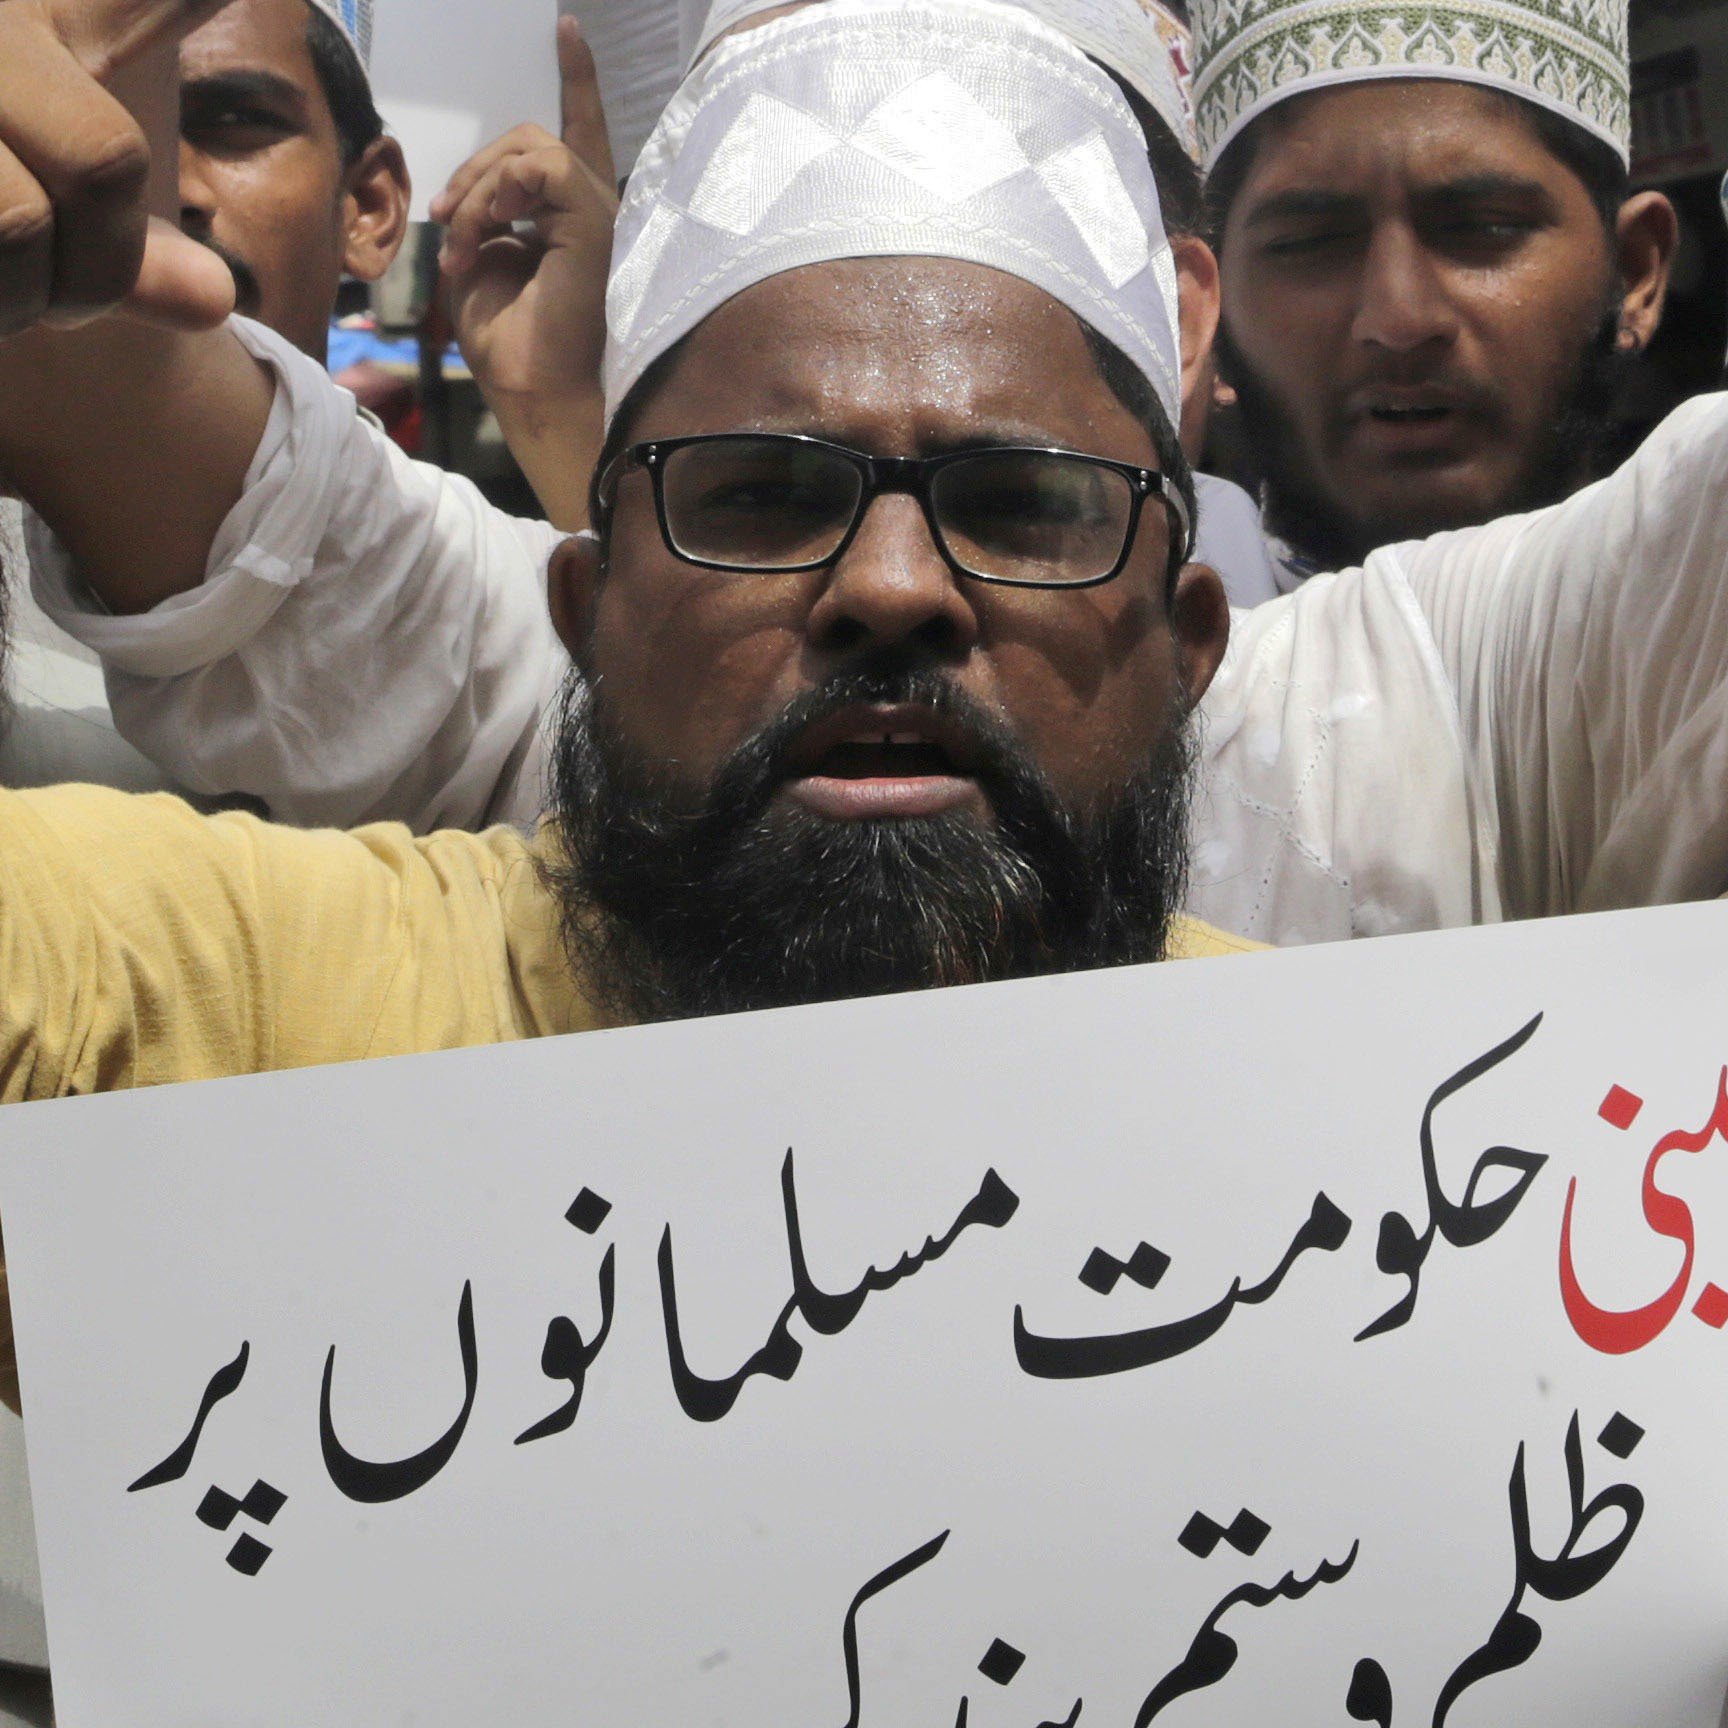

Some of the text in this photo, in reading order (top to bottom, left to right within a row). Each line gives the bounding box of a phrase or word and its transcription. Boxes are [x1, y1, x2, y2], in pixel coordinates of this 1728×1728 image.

[317, 1145, 1021, 1505] مسلمانوں
[1010, 1011, 1550, 1380] حکومت
[127, 1338, 289, 1577] پر
